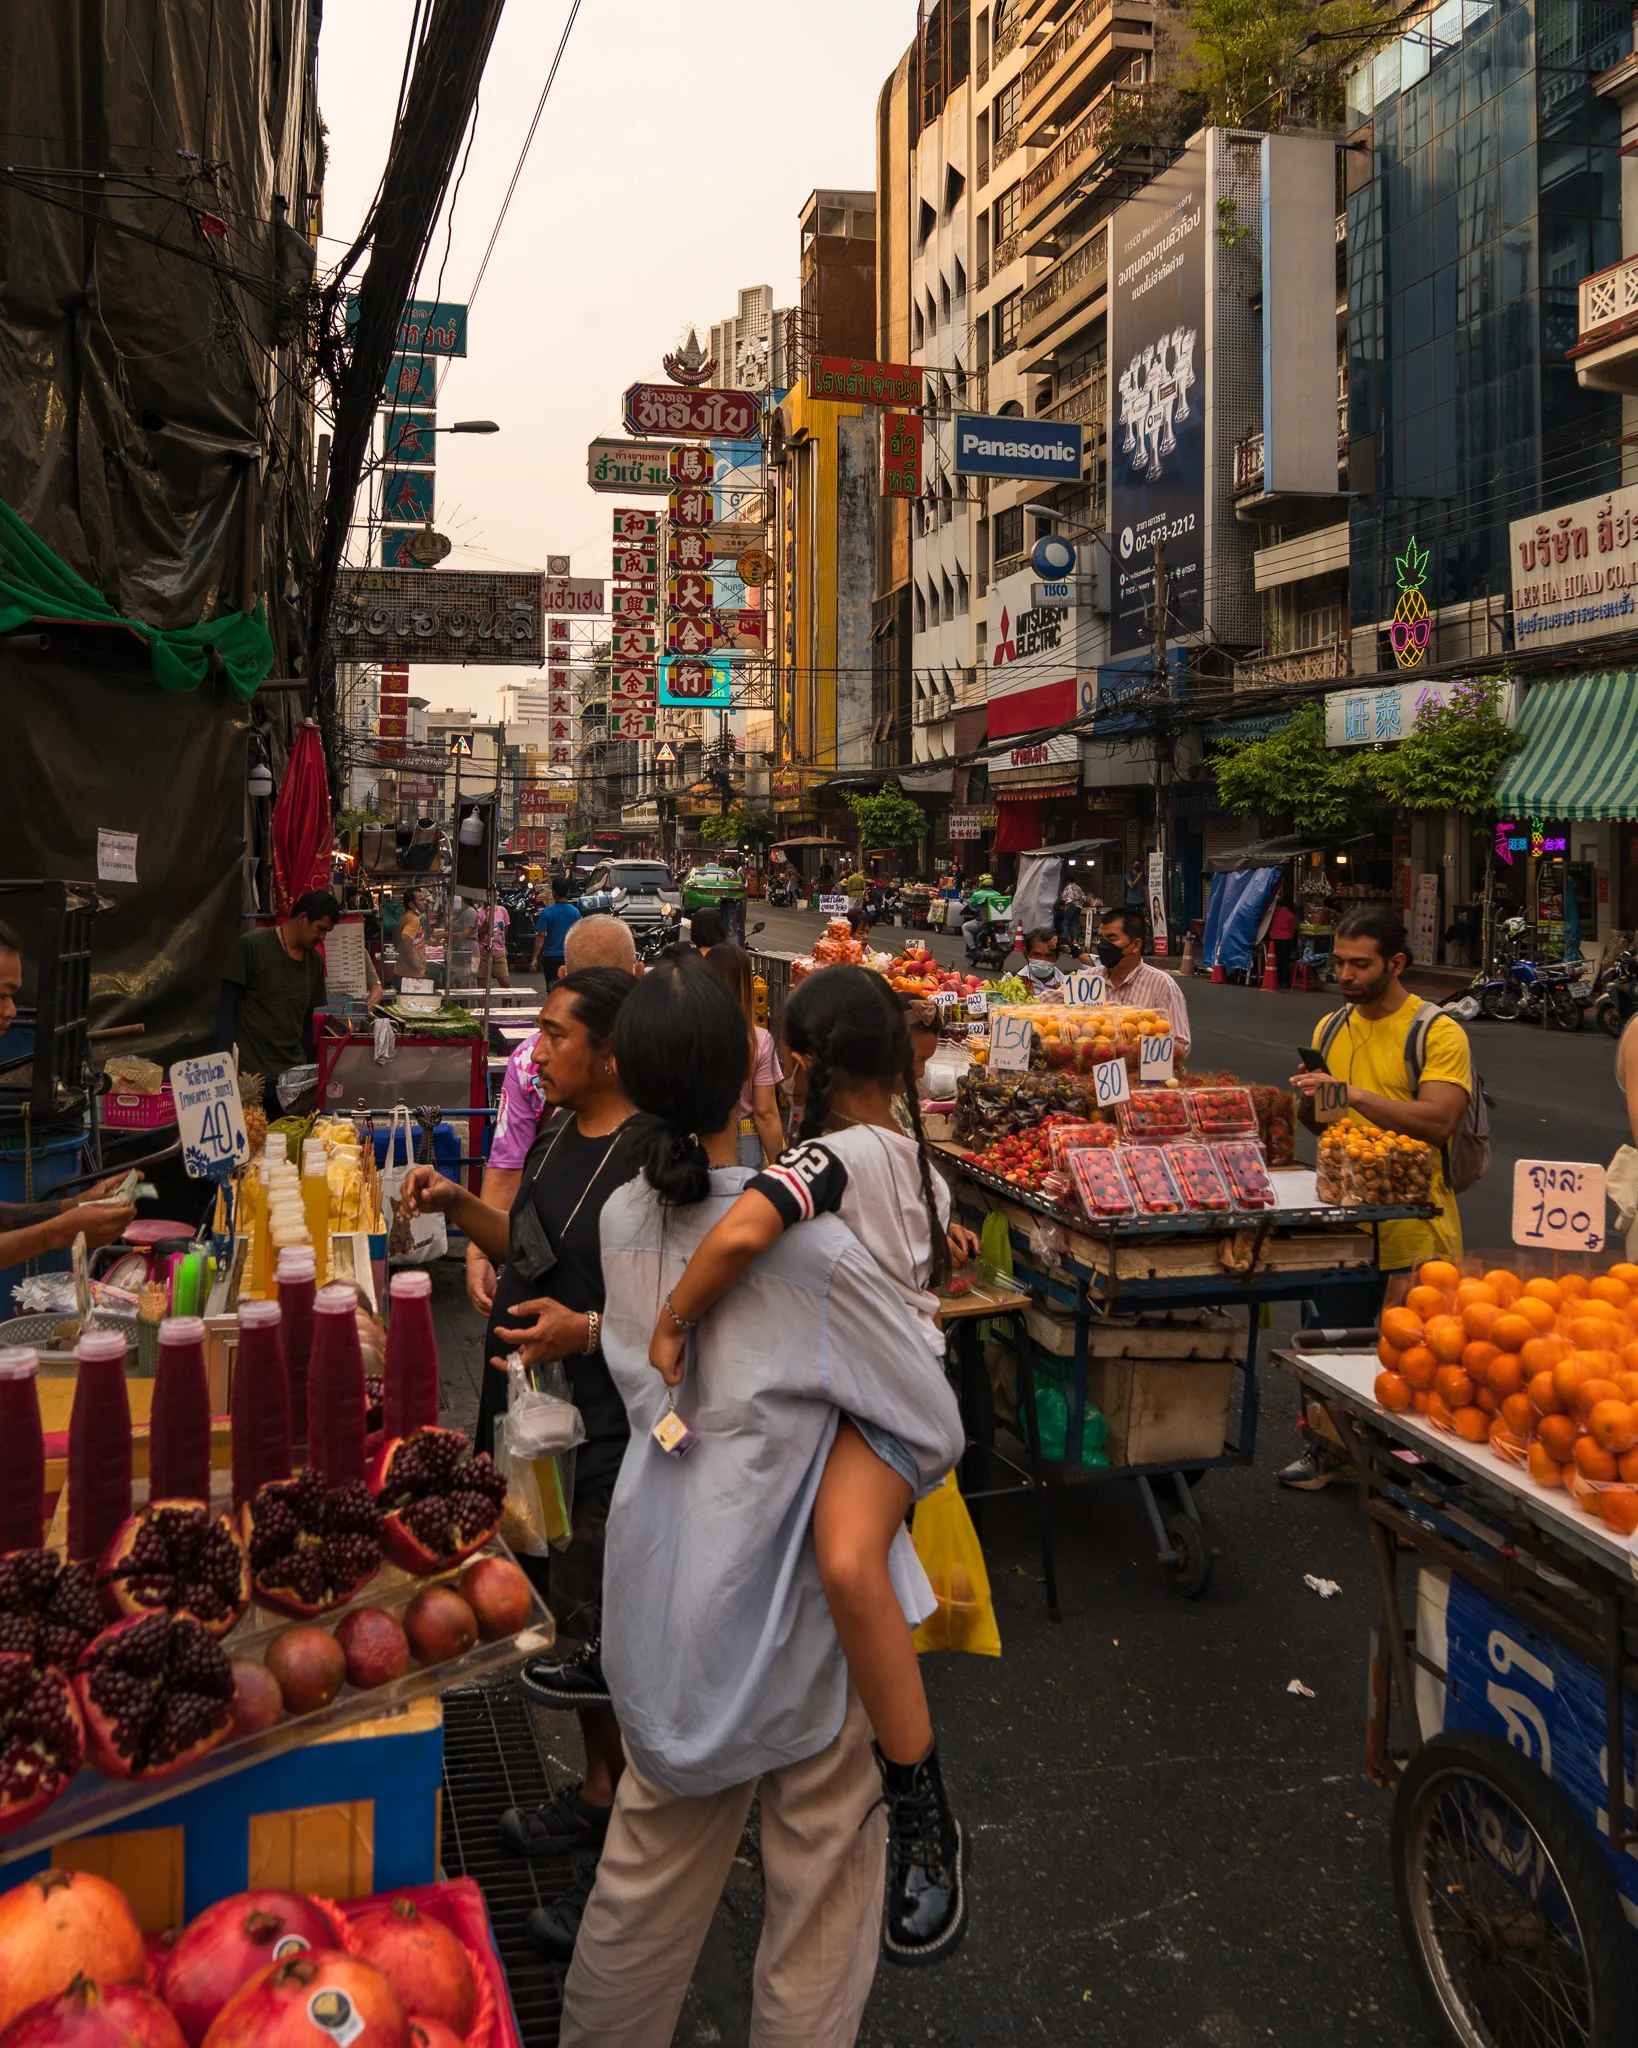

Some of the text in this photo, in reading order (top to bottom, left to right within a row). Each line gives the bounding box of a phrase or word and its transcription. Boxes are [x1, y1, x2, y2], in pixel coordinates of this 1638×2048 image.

[1124, 191, 1193, 254] TISCO Wealth Advisory
[640, 388, 693, 405] ห้างทอง
[811, 359, 921, 402] โรงรับจำนำ
[962, 433, 1076, 462] Panasonic
[1518, 516, 1589, 572] บริษัท
[1043, 583, 1068, 597] TISCO
[1514, 584, 1540, 611] LEE
[1541, 579, 1562, 605] HA
[1563, 569, 1604, 601] HUAD
[1016, 606, 1069, 637] MITSUBISHI
[1016, 624, 1062, 658] ELECTRIC
[521, 790, 535, 805] 24
[968, 994, 982, 1006] 400
[1064, 976, 1103, 1006] 100
[969, 1024, 984, 1035] 200
[993, 1016, 1034, 1050] 150
[1142, 1037, 1173, 1065] 100
[1096, 1061, 1122, 1101] 80
[1316, 1081, 1348, 1112] 100
[199, 1101, 233, 1158] 40
[1528, 1165, 1584, 1199] ถุงละ
[1525, 1200, 1591, 1239] 100
